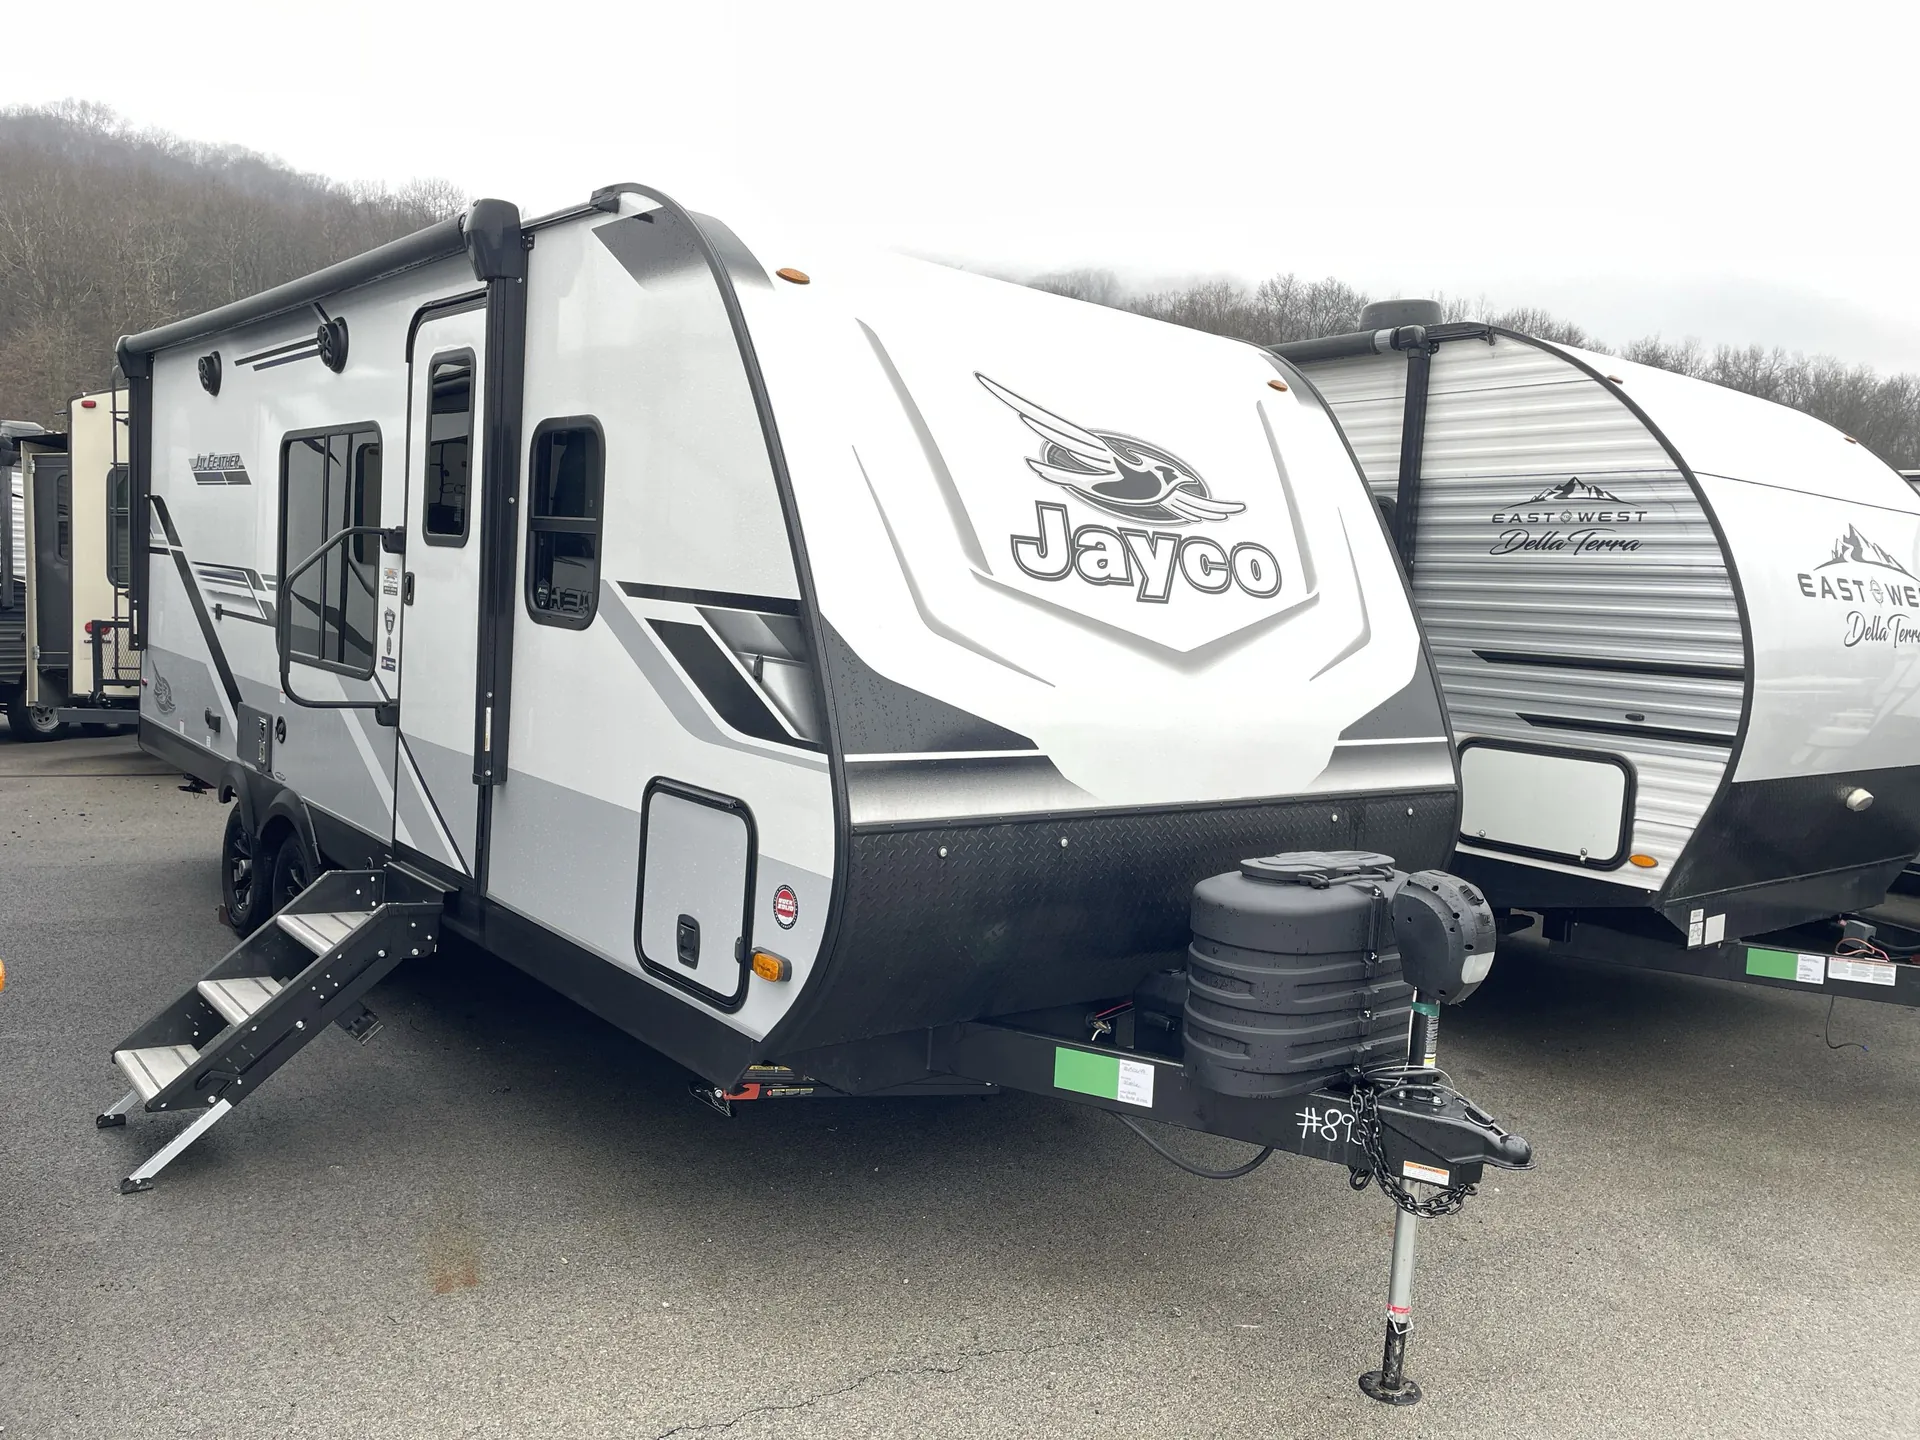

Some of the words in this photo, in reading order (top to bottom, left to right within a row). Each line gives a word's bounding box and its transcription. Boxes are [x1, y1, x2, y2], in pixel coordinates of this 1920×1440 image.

[1491, 513, 1555, 524] EAST
[1578, 511, 1648, 523] WEST
[1010, 500, 1282, 604] Jayco
[1489, 528, 1567, 555] Della
[1567, 528, 1644, 556] Terra
[1797, 573, 1865, 602] EAST
[1884, 583, 1920, 608] WE
[1844, 610, 1889, 647] Della
